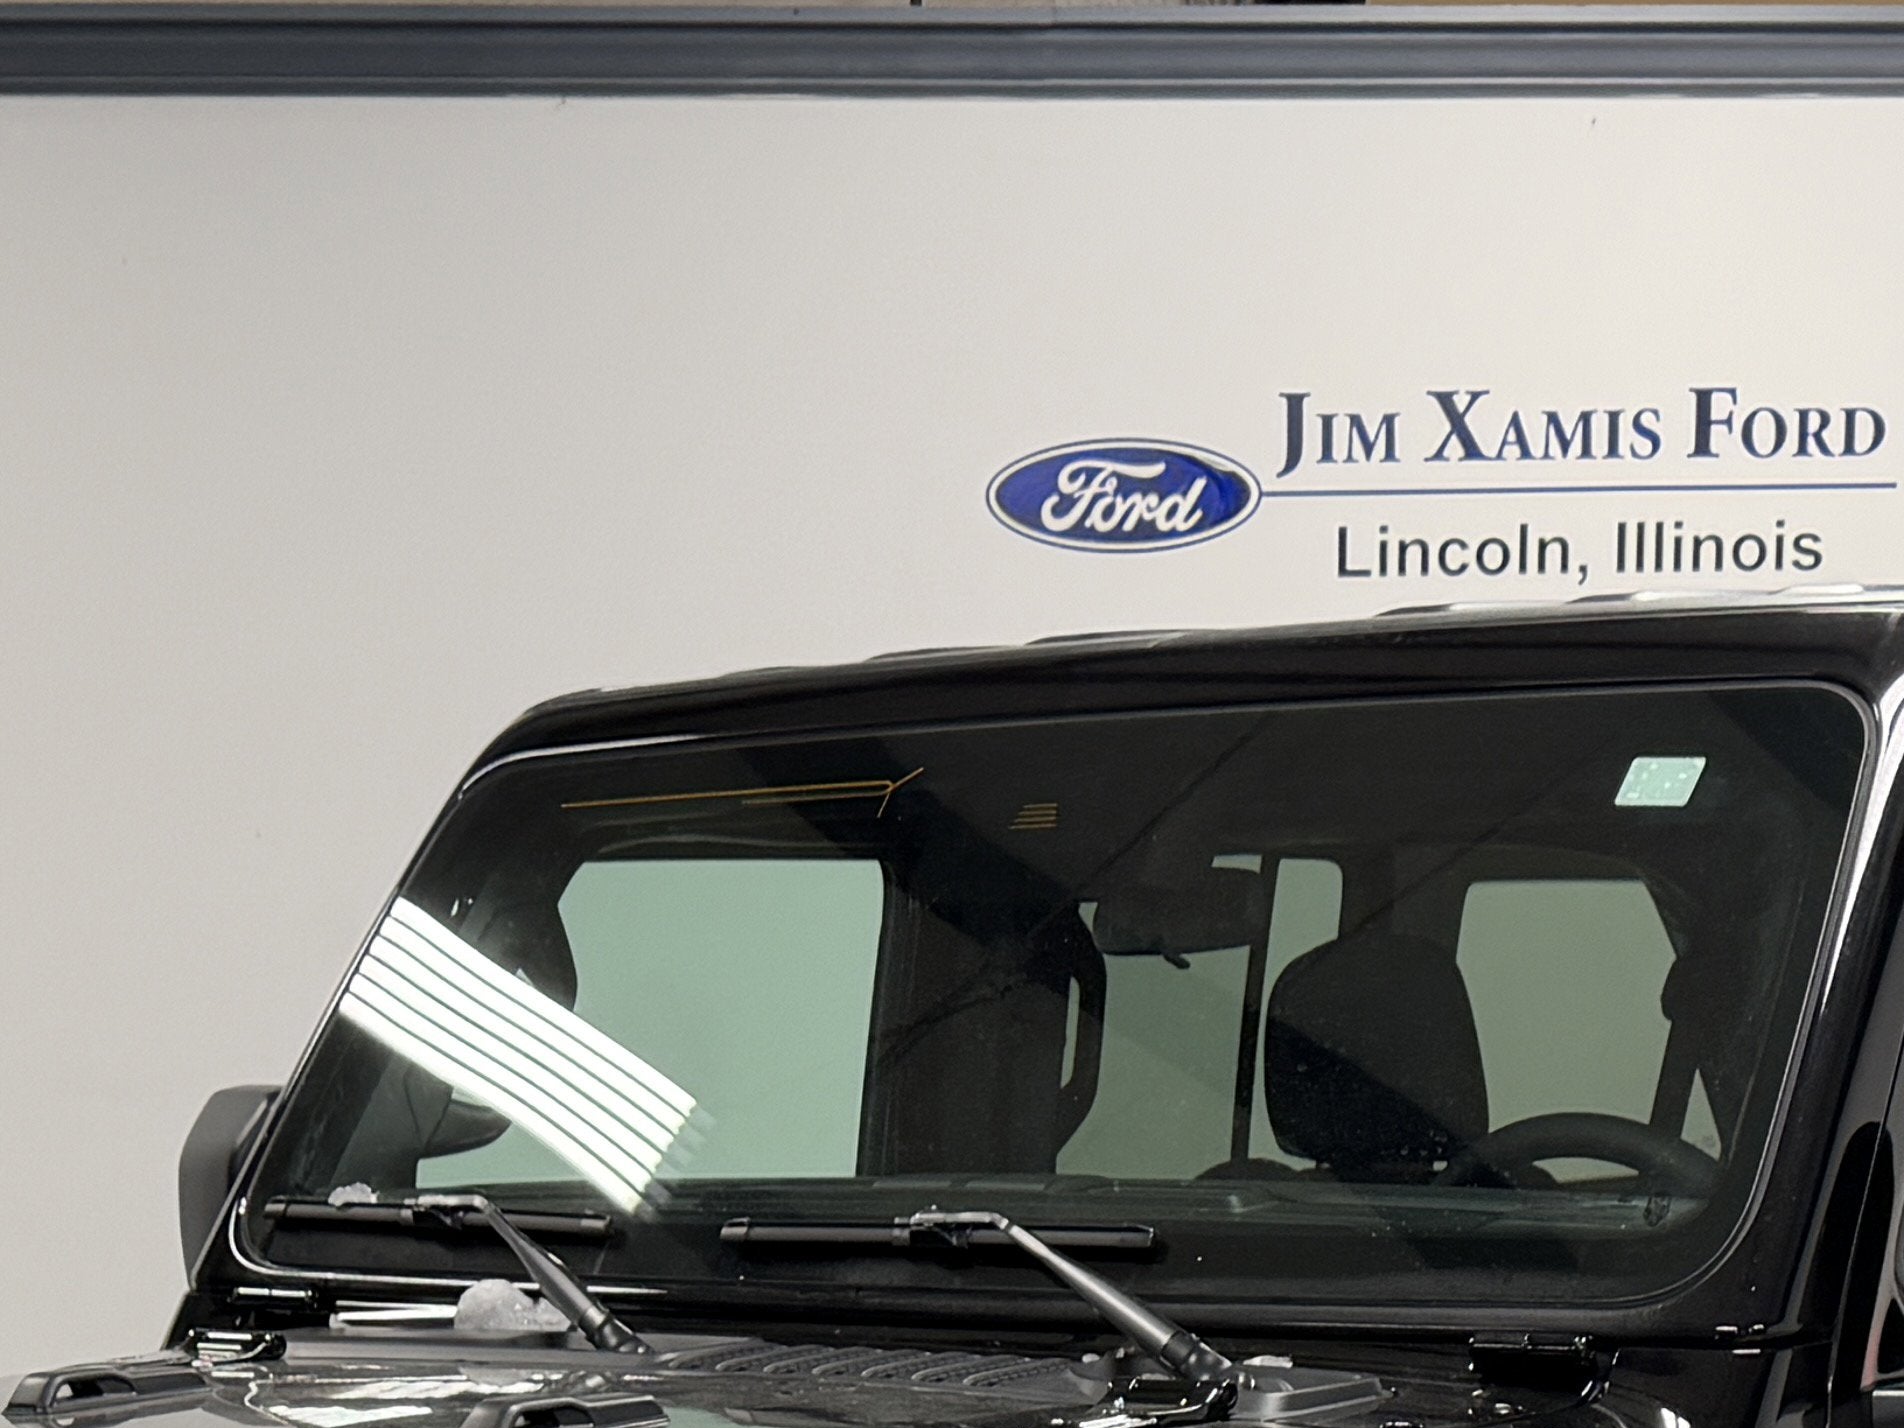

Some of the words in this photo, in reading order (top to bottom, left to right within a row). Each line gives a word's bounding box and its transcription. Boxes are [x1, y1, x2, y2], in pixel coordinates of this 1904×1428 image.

[1276, 392, 1401, 478] JIM
[1423, 389, 1661, 462] XAMIS
[1686, 387, 1886, 459] FORD
[1040, 461, 1205, 532] Ford
[1337, 523, 1588, 585] Lincoln,
[1616, 519, 1823, 573] Illinois
